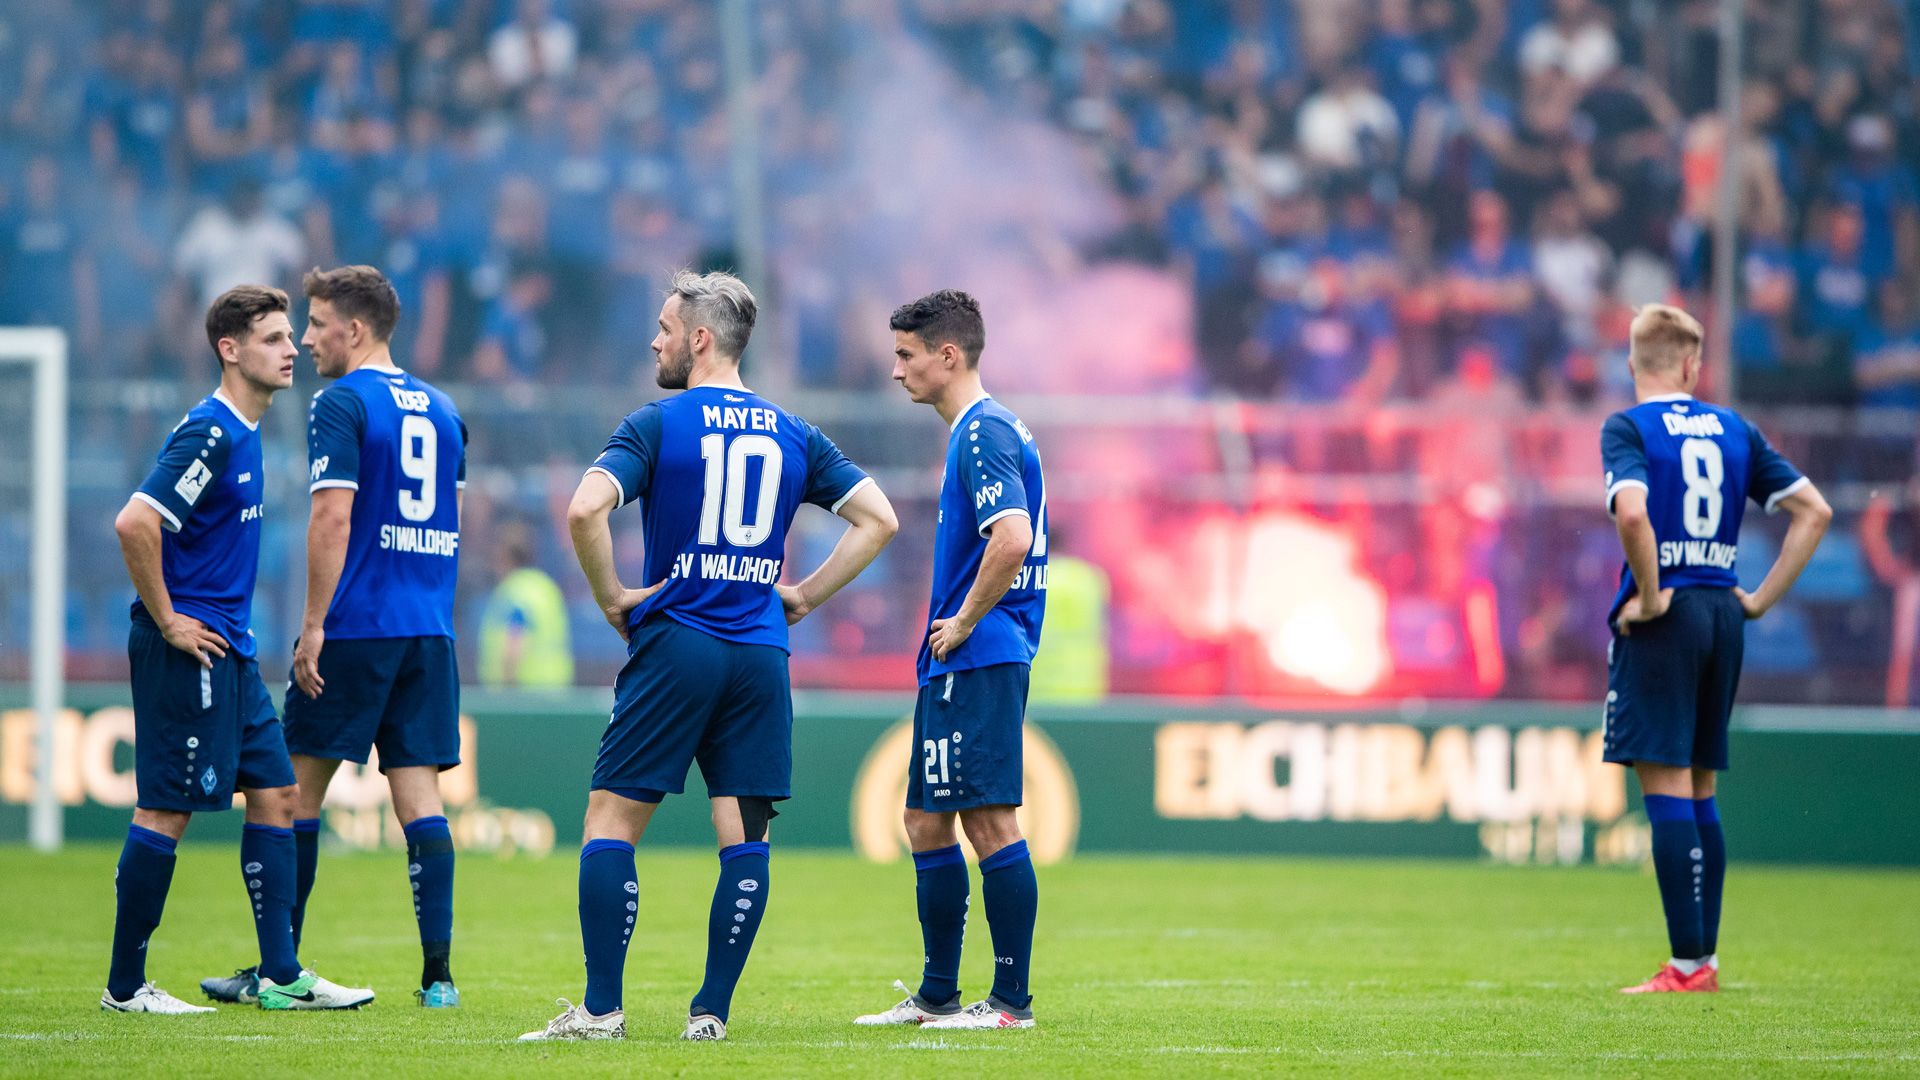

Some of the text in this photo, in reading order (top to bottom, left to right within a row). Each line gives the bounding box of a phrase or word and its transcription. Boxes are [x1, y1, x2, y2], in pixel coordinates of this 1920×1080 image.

[702, 405, 779, 434] MAYER
[398, 414, 437, 522] 9
[698, 433, 783, 547] 10
[1680, 437, 1724, 539] 8
[1660, 541, 1684, 567] SV
[924, 738, 949, 784] 21
[934, 789, 951, 797] JAKO
